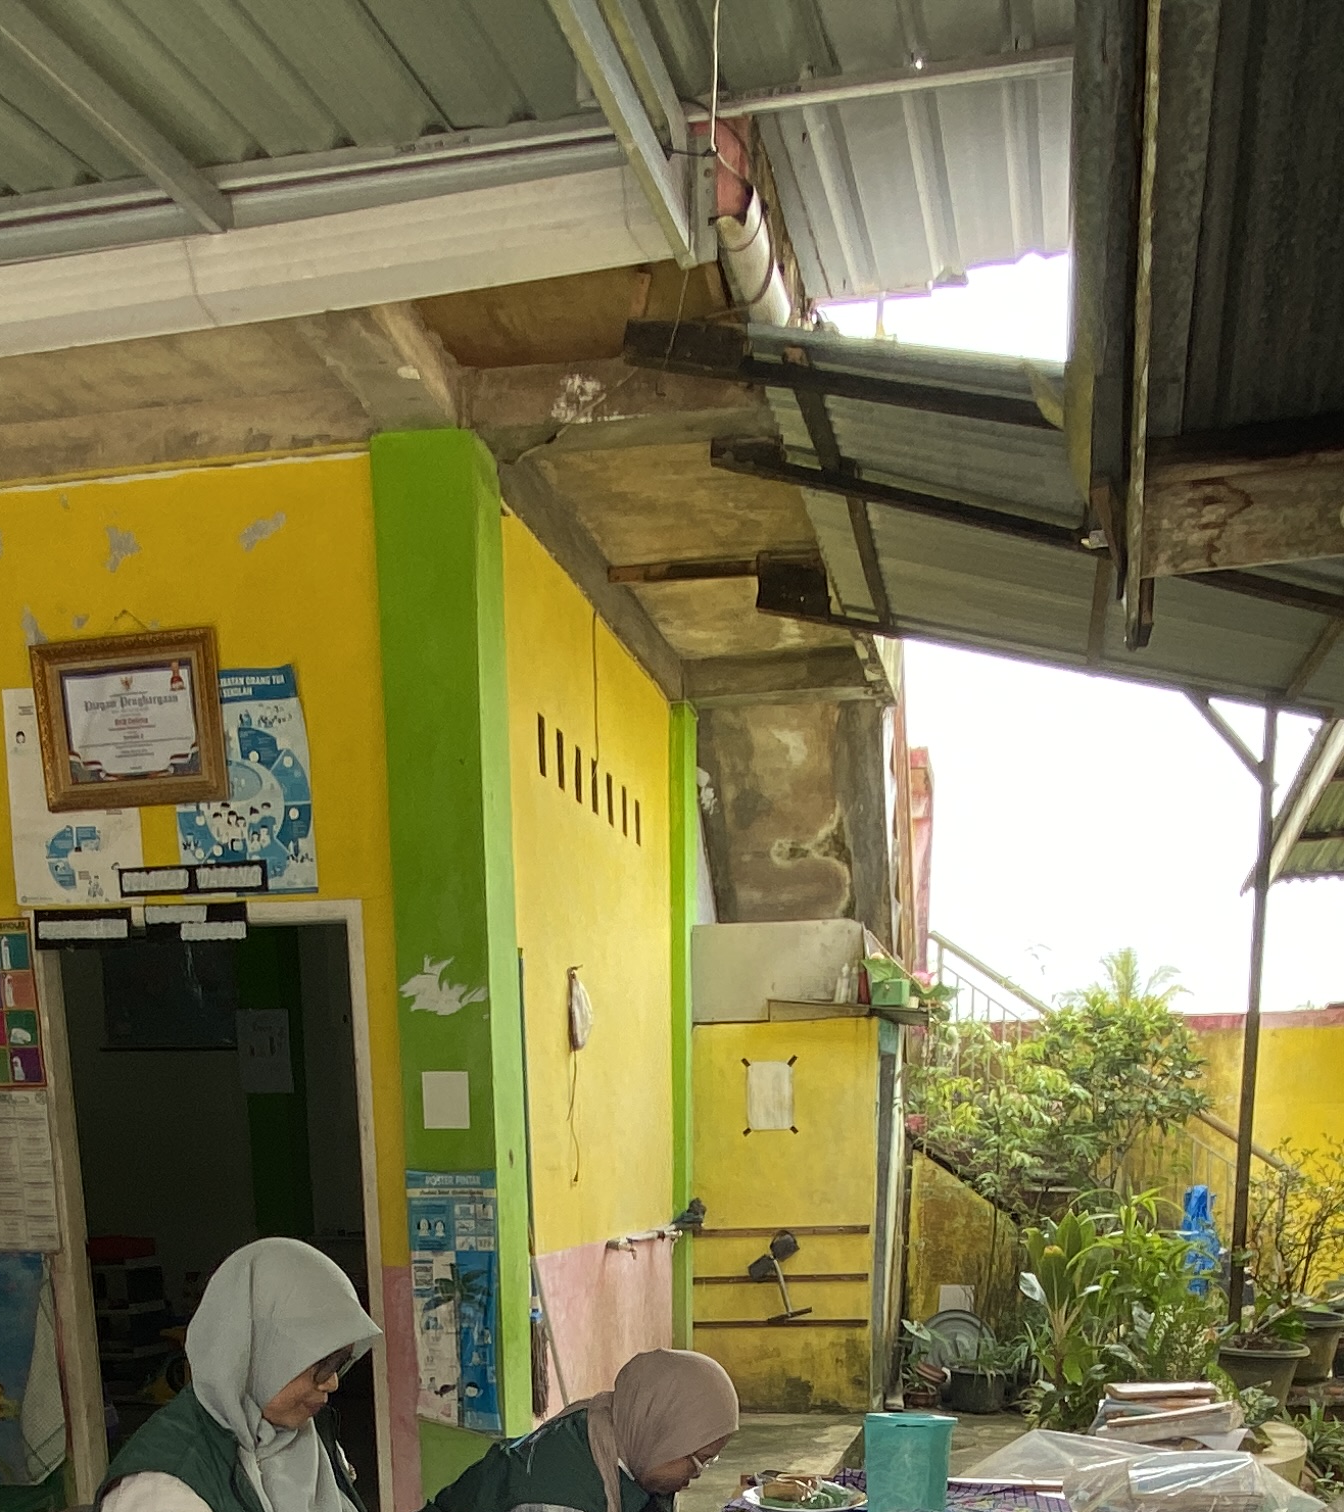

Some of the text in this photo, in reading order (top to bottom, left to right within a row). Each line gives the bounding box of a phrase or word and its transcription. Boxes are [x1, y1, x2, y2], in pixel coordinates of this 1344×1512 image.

[120, 694, 179, 709] Penghargaan
[425, 1175, 481, 1186] POSTER PINTAR
